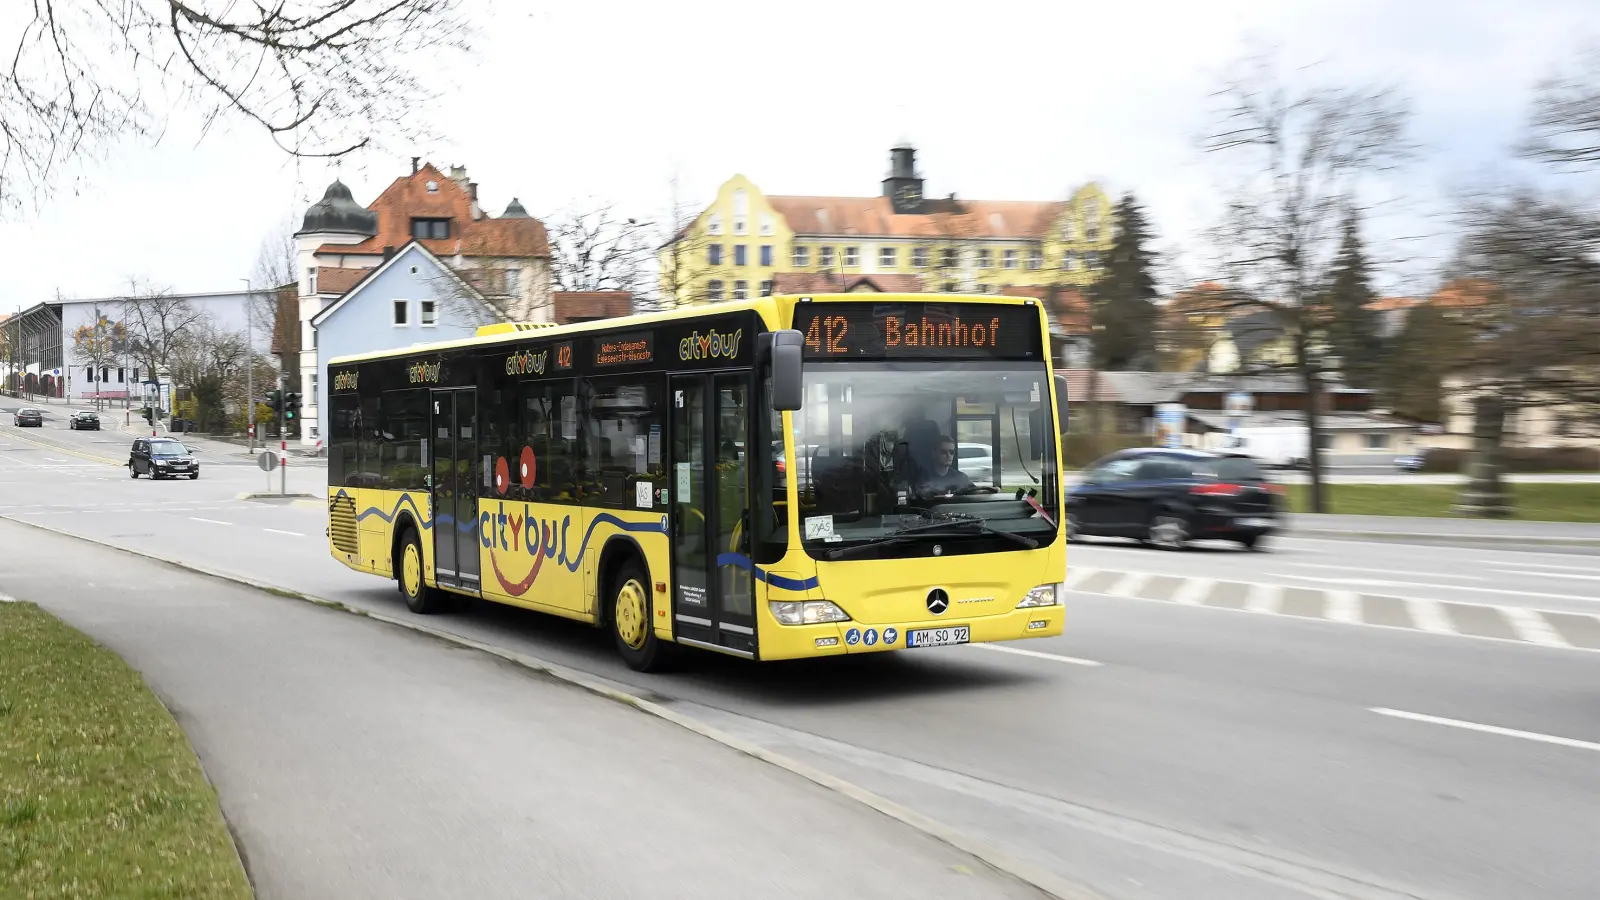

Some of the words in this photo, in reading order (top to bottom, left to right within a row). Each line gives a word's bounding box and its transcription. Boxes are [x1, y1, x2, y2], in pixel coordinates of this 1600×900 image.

[805, 315, 848, 352] 412
[886, 316, 999, 347] Bahnhof
[558, 346, 571, 367] 412
[916, 631, 929, 644] AM
[935, 629, 949, 642] SO
[954, 628, 967, 641] 92
